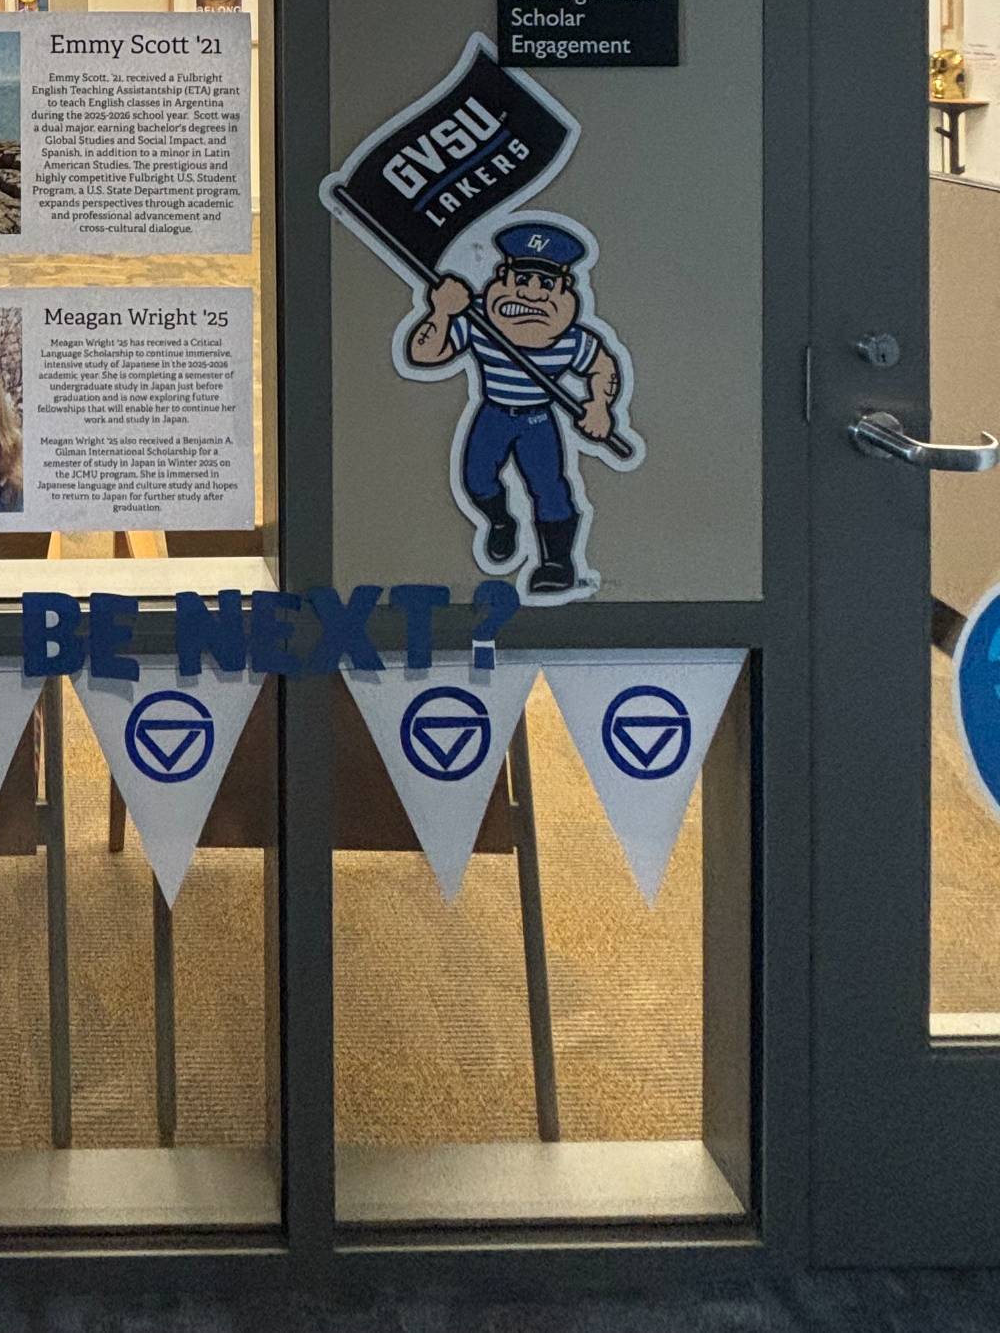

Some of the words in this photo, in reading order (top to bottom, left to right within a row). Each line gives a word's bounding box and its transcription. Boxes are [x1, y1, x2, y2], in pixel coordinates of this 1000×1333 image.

[511, 8, 586, 28] Scholar
[50, 34, 126, 60] Emmy
[130, 34, 191, 55] Scott
[196, 35, 222, 55] '21
[511, 35, 631, 58] Engagement
[48, 73, 81, 84] Emmy
[125, 73, 167, 82] received
[176, 73, 223, 84] Fulbright
[31, 85, 69, 96] English
[69, 85, 115, 96] Teaching
[115, 85, 183, 96] Assistantship
[212, 87, 241, 97] grant
[47, 99, 58, 107] to
[59, 98, 87, 107] teach
[87, 98, 125, 109] English
[126, 98, 161, 107] classes
[161, 98, 173, 107] in
[174, 99, 225, 109] Argentina
[31, 110, 65, 121] during
[65, 111, 83, 119] the
[131, 111, 165, 119] school
[193, 111, 219, 119] Scott
[383, 97, 504, 201] GVSU
[35, 173, 67, 184] highly
[67, 173, 127, 184] competitive
[128, 173, 175, 184] Fulbright
[196, 173, 237, 182] Student
[425, 137, 531, 229] LAKERS
[38, 198, 81, 209] expands
[81, 199, 144, 209] perspectives
[144, 199, 186, 209] through
[187, 197, 234, 208] academic
[51, 211, 71, 219] and
[71, 211, 133, 222] professional
[133, 211, 201, 220] advancement
[202, 212, 222, 220] and
[79, 223, 147, 233] cross-cultural
[44, 308, 123, 330] Meagan
[128, 307, 198, 330] Wright
[203, 309, 230, 328] '25
[49, 382, 113, 392] undergraduate
[113, 382, 139, 392] study
[150, 382, 177, 391] Japan
[177, 382, 194, 392] just
[195, 382, 224, 390] before
[22, 592, 140, 682] BE
